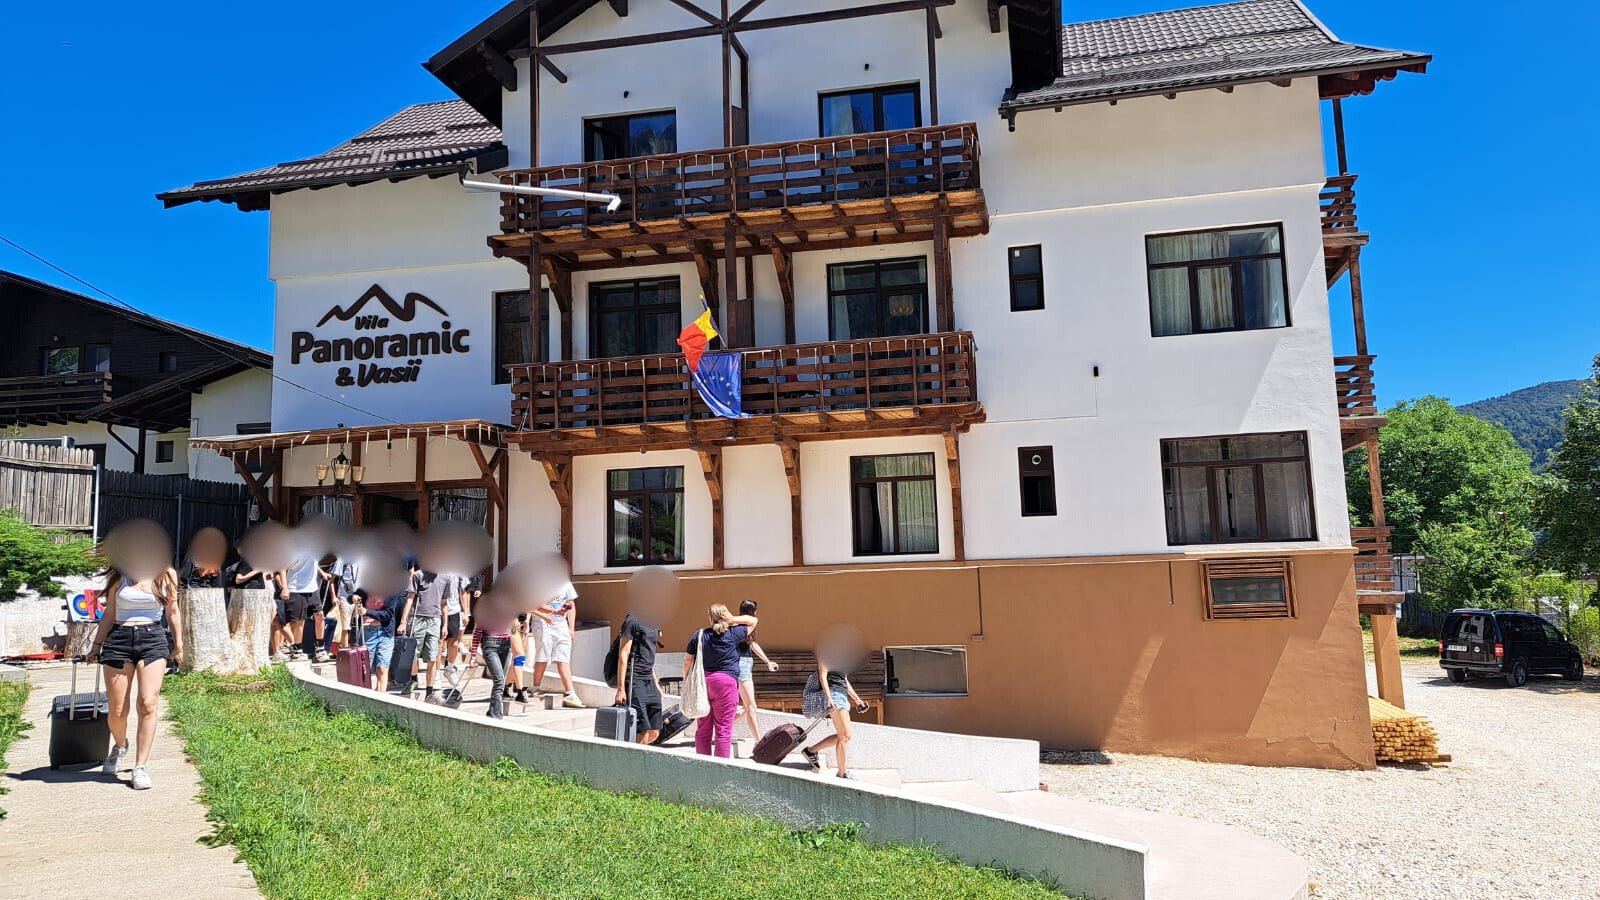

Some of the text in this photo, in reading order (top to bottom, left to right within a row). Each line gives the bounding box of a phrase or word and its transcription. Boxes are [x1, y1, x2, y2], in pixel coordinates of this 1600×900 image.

[354, 315, 389, 330] Vila
[291, 320, 470, 364] Panoramic
[335, 358, 422, 387] & Vasii
